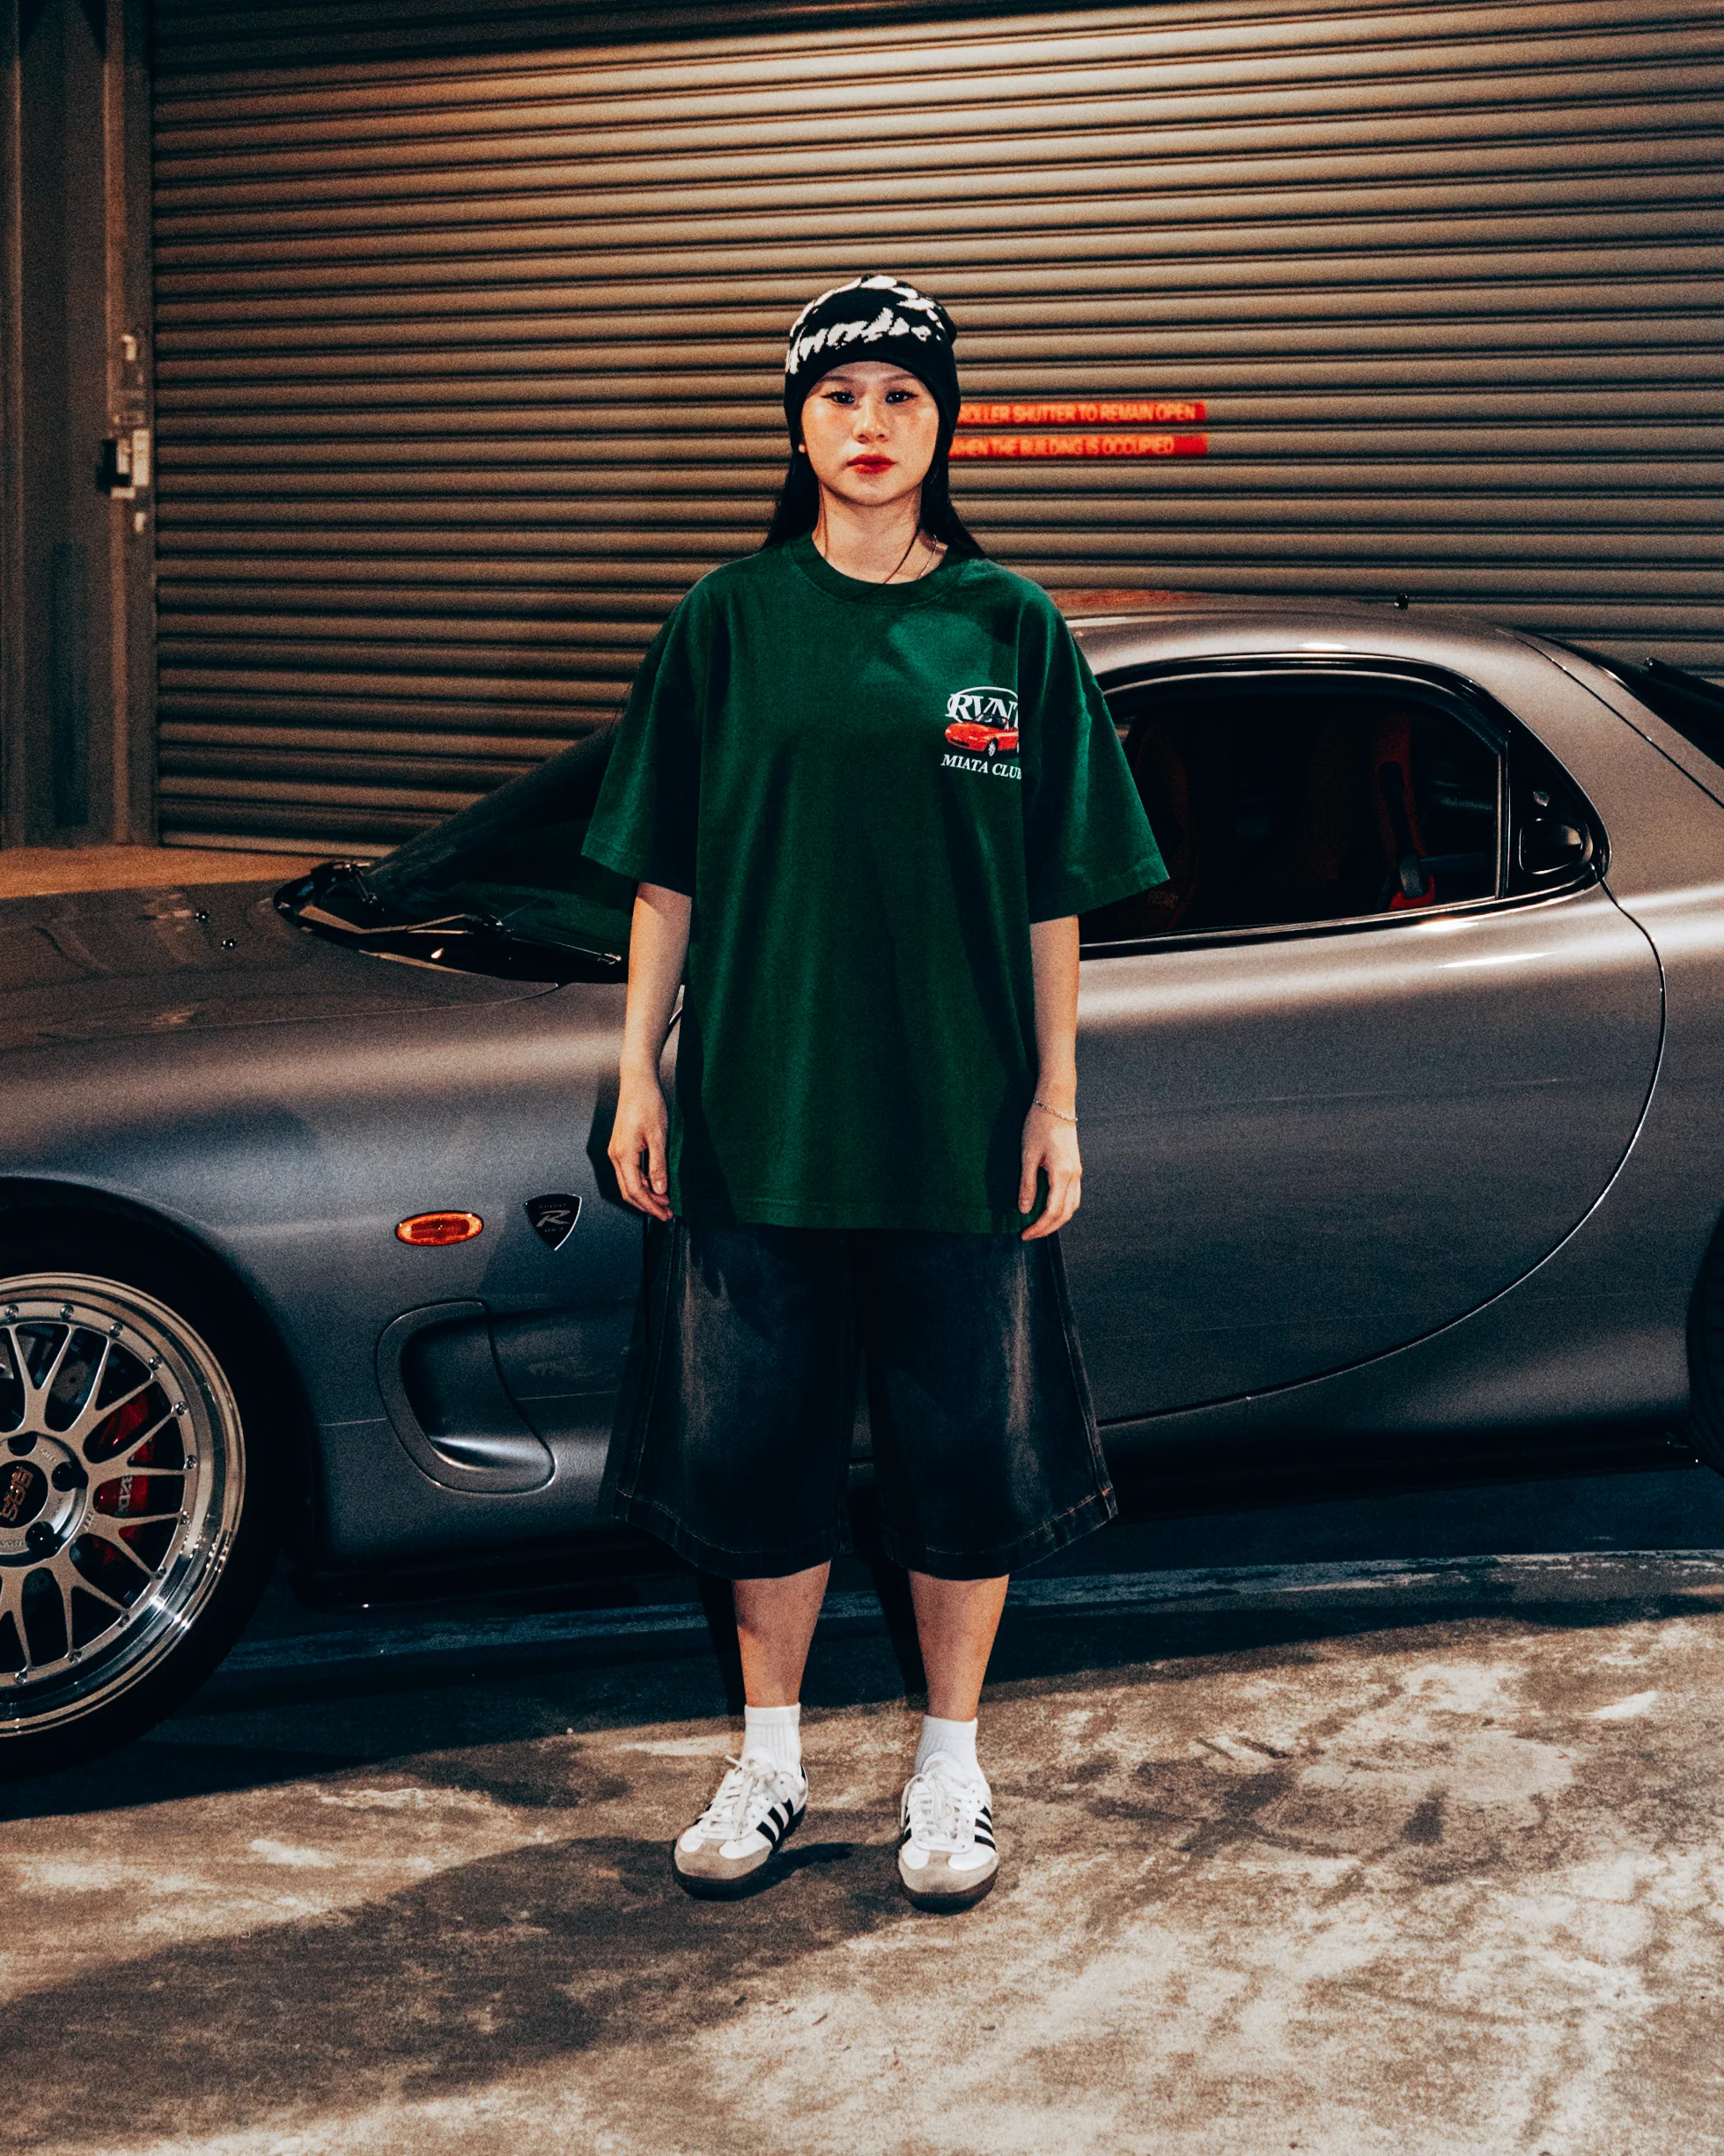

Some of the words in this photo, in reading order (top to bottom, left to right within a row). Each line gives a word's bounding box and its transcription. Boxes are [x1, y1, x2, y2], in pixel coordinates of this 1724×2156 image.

[1078, 403, 1098, 421] TO
[1100, 402, 1153, 421] REMAIN
[1155, 402, 1196, 420] OPEN
[940, 754, 989, 774] MIATA
